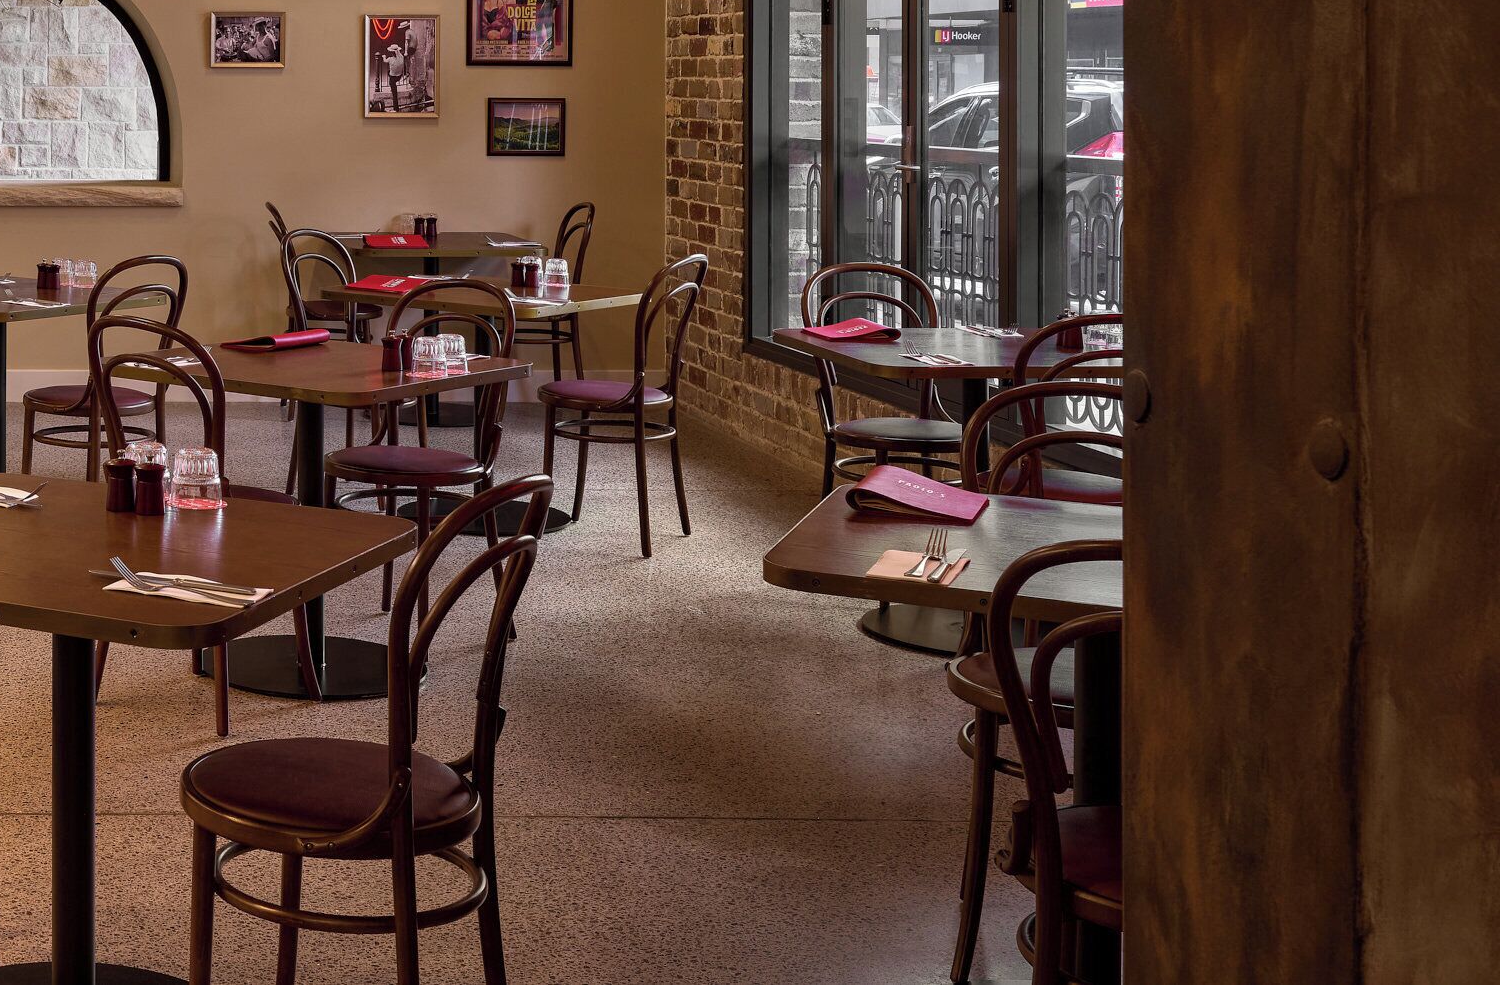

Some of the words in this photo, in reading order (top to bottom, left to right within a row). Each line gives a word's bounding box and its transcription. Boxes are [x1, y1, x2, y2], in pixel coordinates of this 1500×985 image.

[507, 6, 536, 18] DOLCE
[514, 18, 537, 31] VITA
[942, 30, 950, 42] LJ
[951, 31, 981, 40] Hooker
